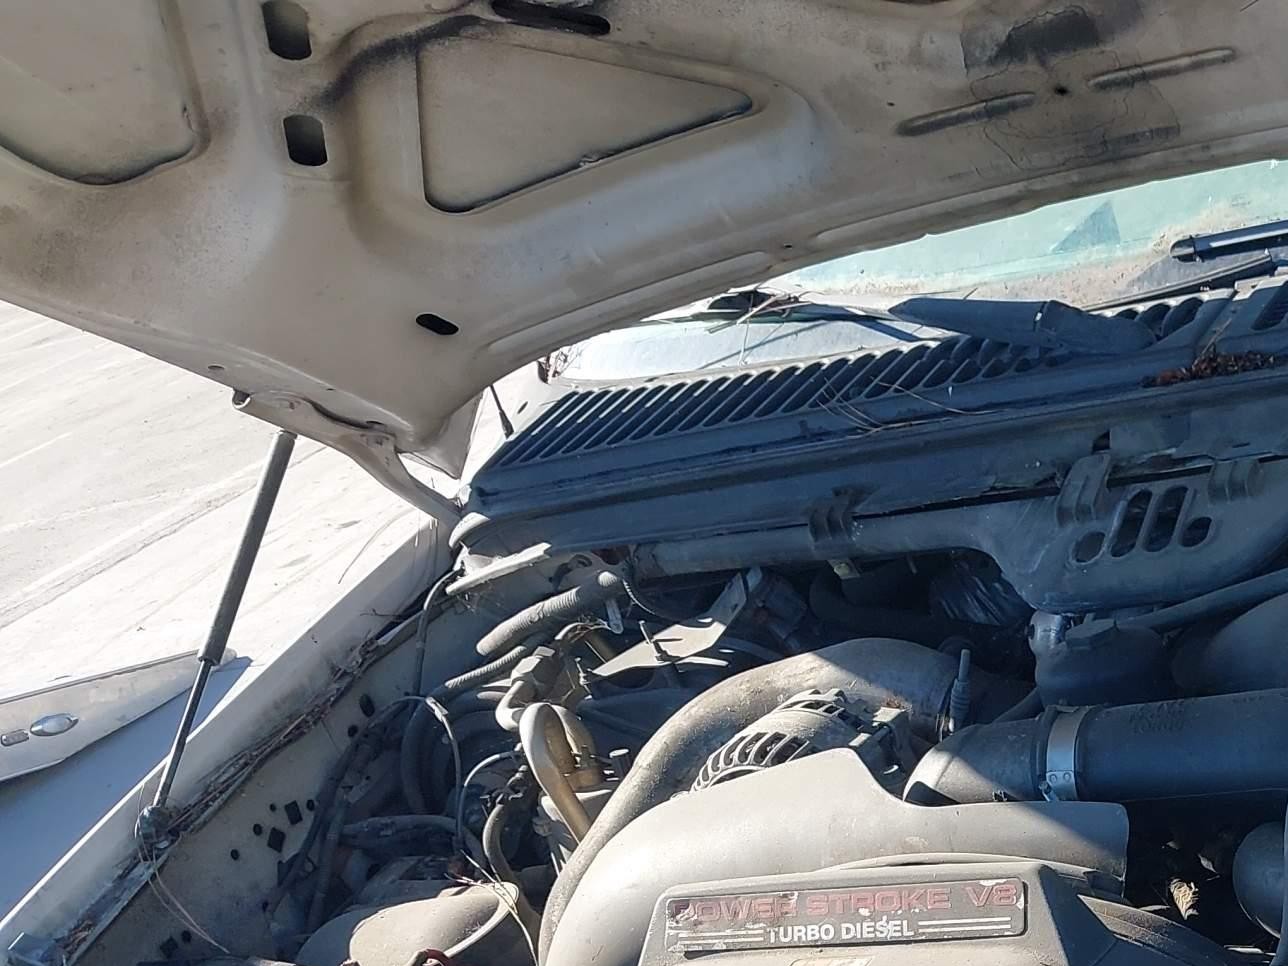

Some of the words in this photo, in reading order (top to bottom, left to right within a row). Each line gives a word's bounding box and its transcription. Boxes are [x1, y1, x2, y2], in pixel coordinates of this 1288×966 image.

[806, 886, 952, 917] STROKE
[963, 883, 1018, 908] V8
[767, 923, 836, 943] TURBO
[840, 918, 915, 941] DIESEL
